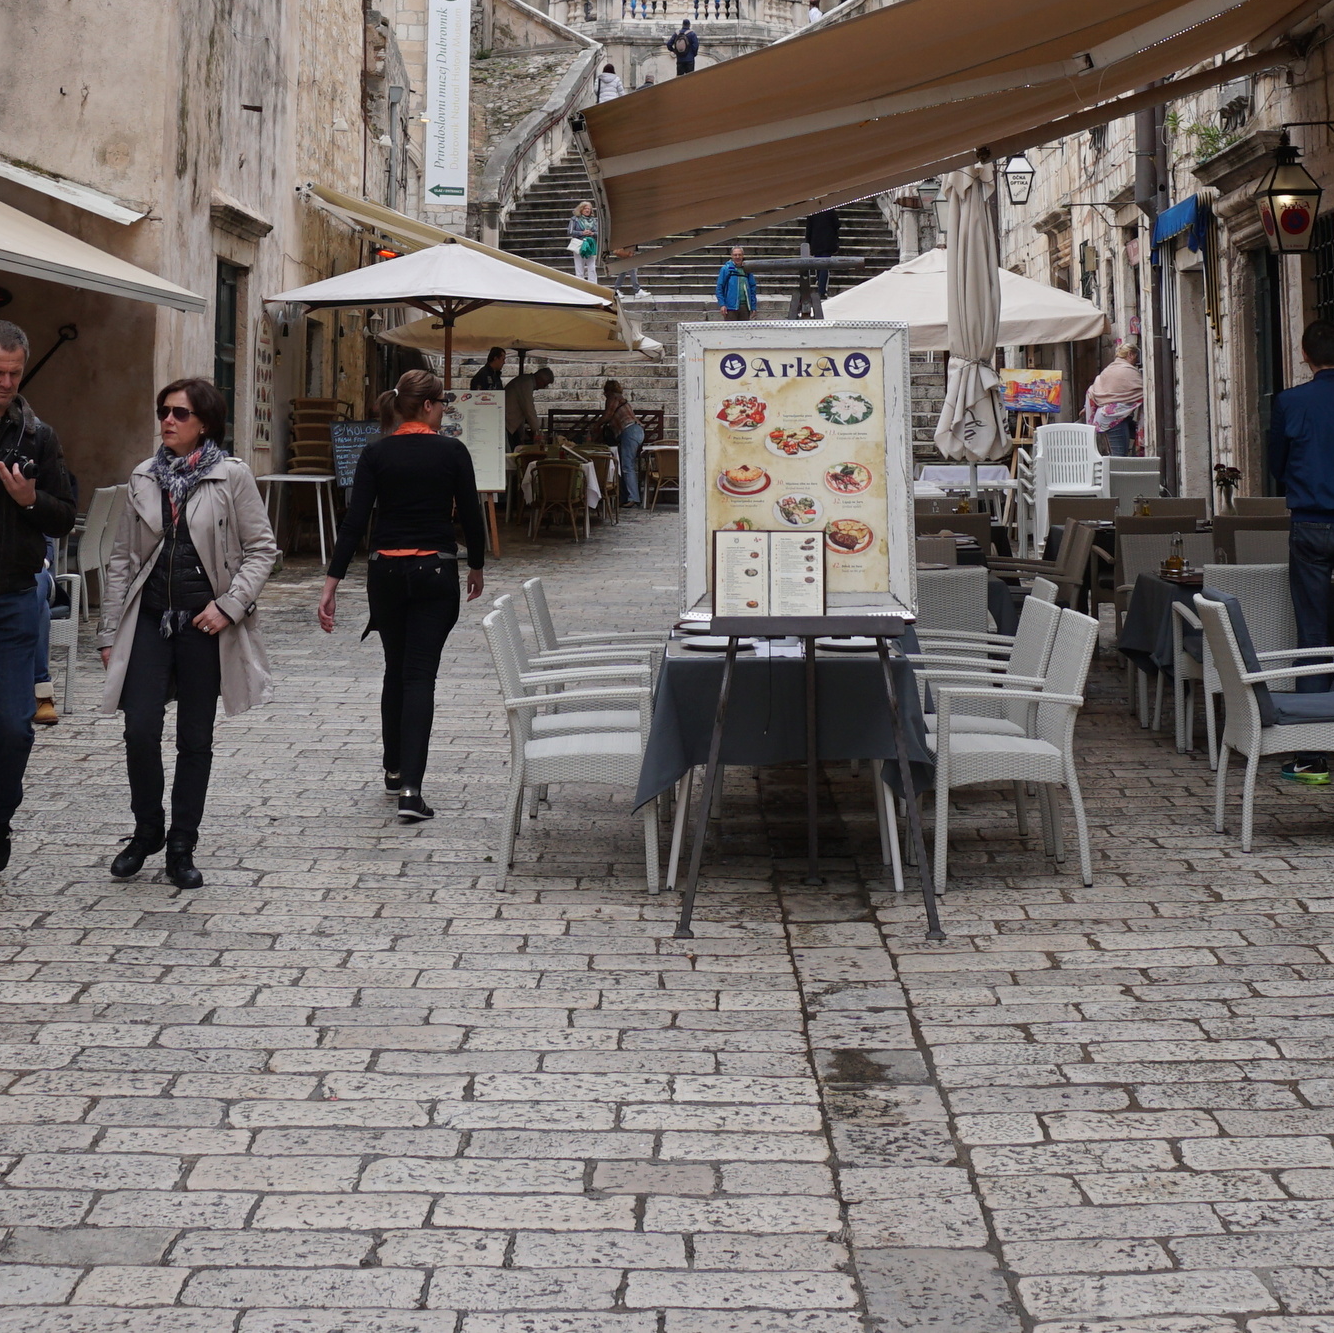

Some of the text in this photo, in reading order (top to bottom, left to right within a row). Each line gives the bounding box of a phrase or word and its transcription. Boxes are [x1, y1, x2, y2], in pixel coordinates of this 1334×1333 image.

[434, 8, 450, 169] Prirodoslovni muzej Dubrovnik
[449, 8, 462, 170] Dubrovnik Natural History Museum
[750, 356, 843, 378] ArkA
